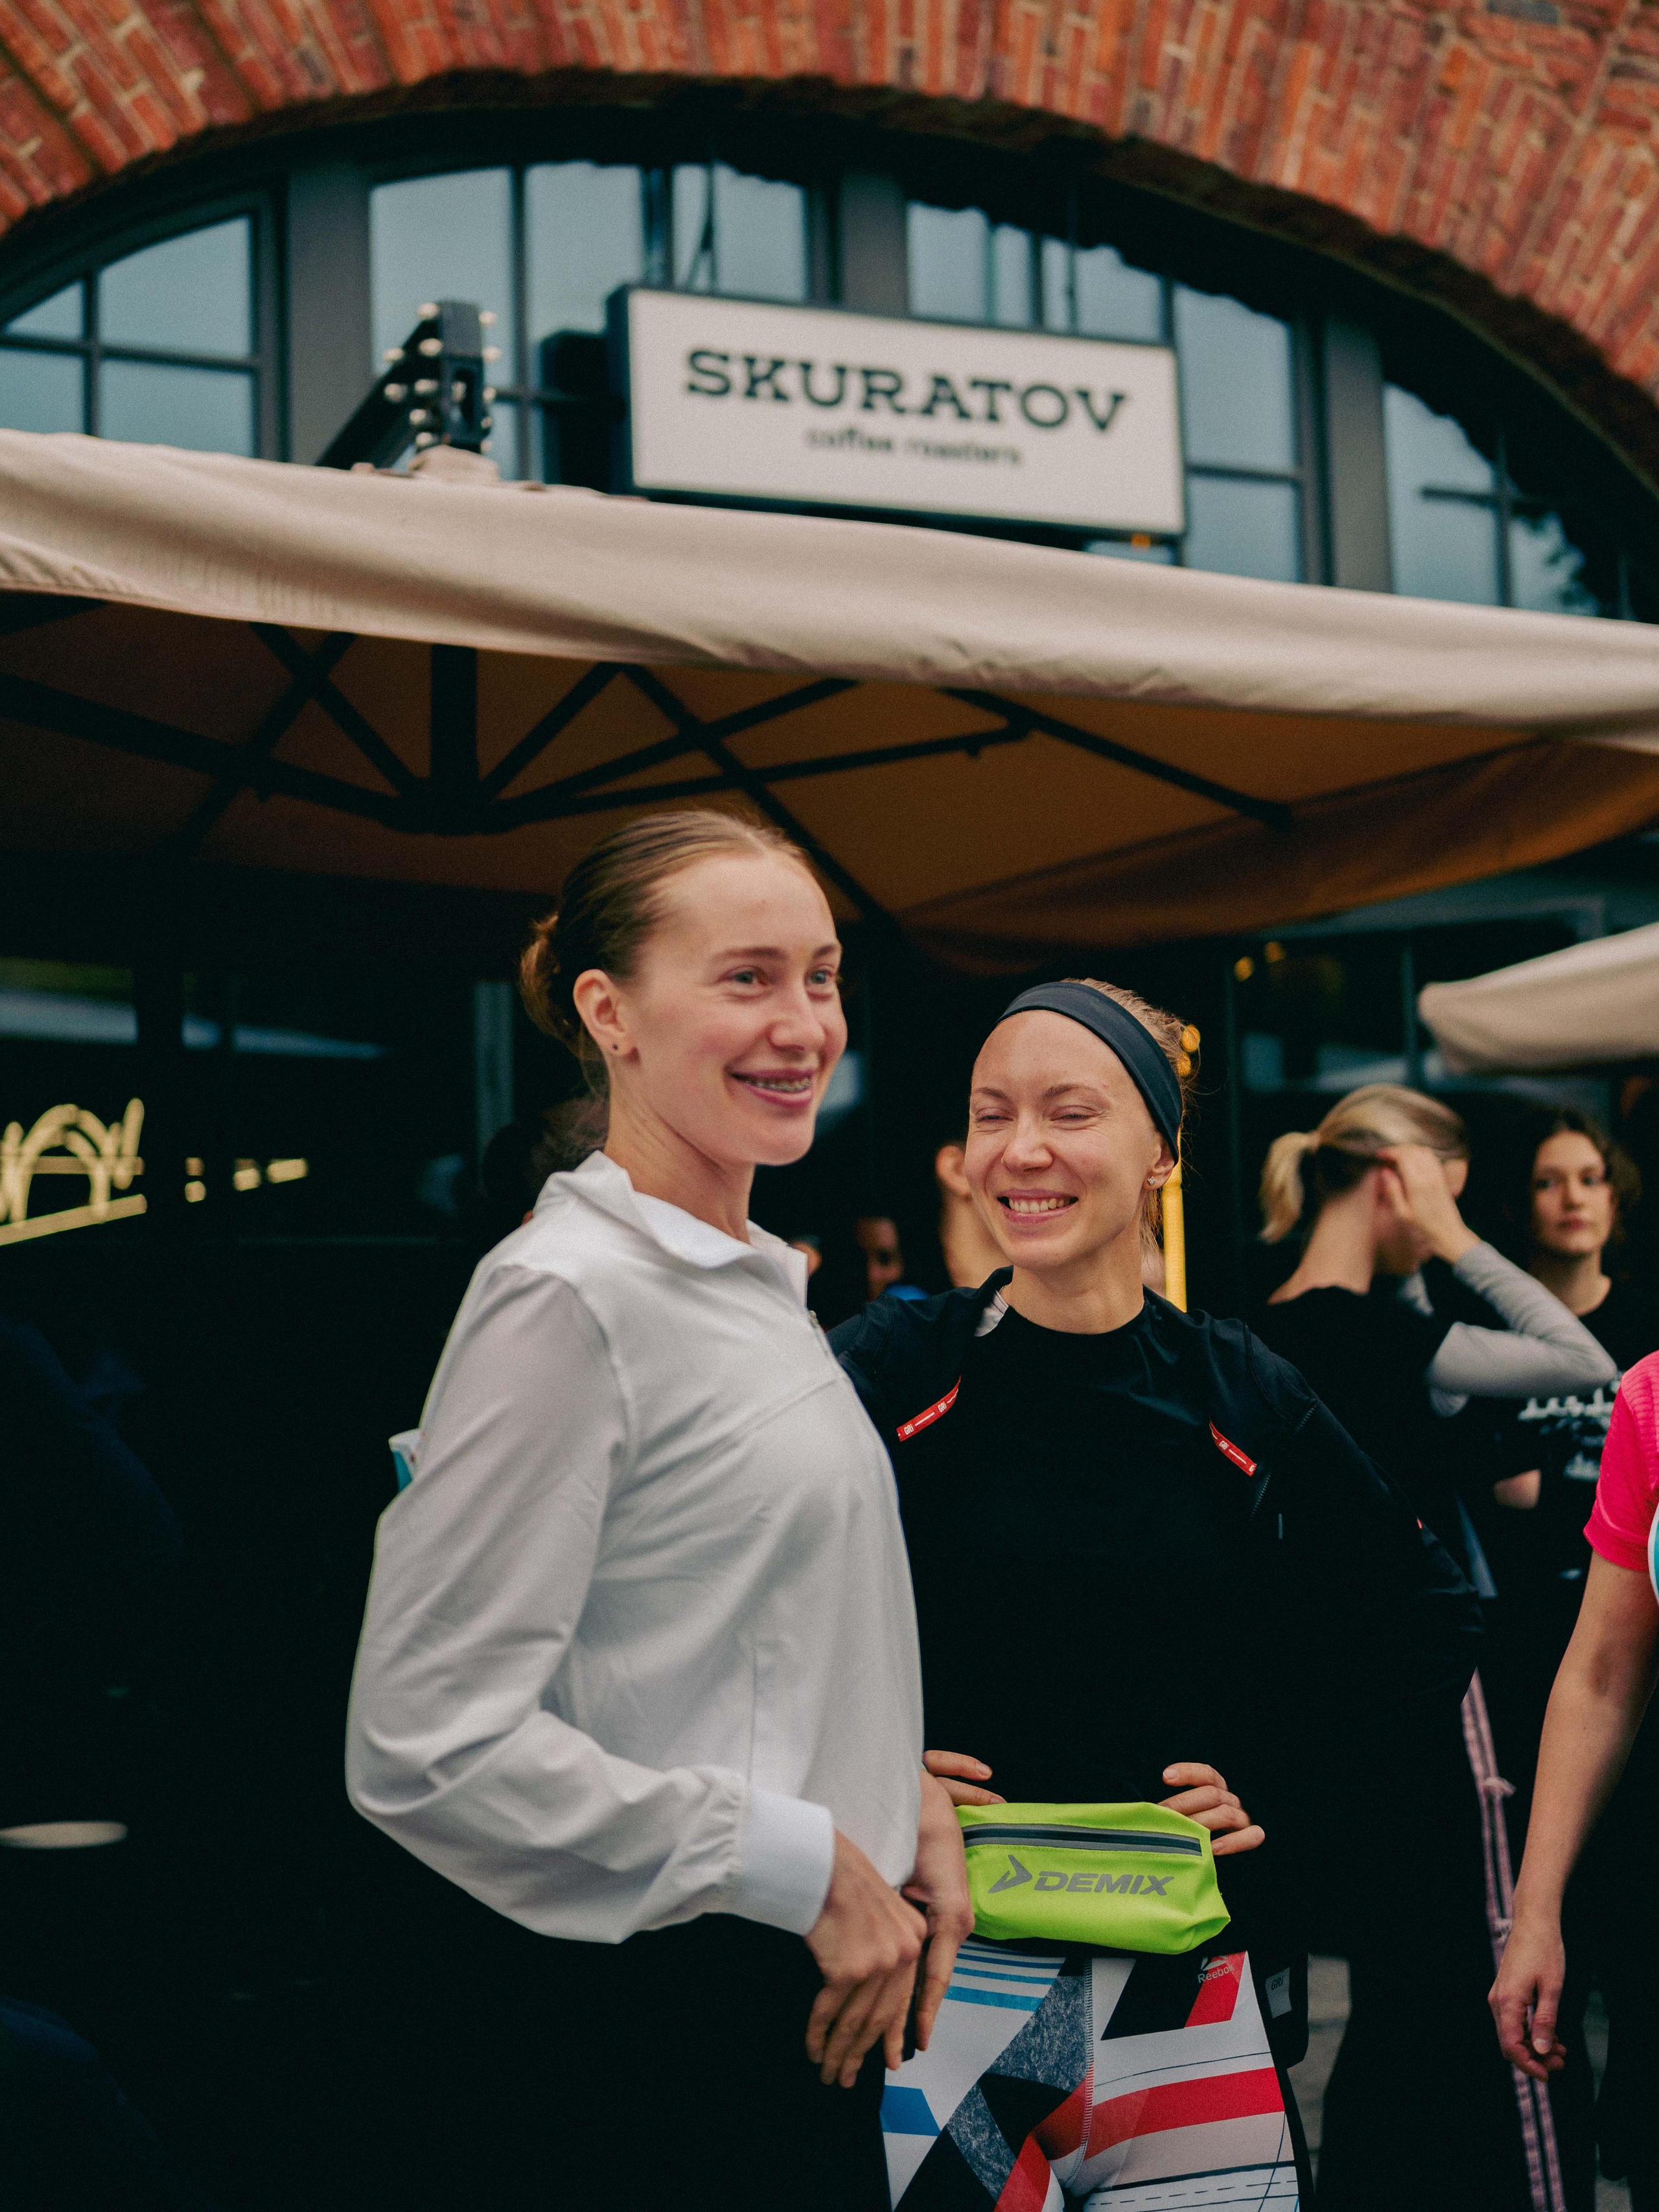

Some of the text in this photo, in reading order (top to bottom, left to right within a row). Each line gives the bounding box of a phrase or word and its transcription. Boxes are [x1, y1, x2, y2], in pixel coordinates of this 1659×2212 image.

[687, 349, 1128, 432] SKURATOV
[806, 425, 892, 452] coffee
[1034, 1870, 1174, 1896] DEMIX
[1198, 1964, 1234, 1983] Reebok
